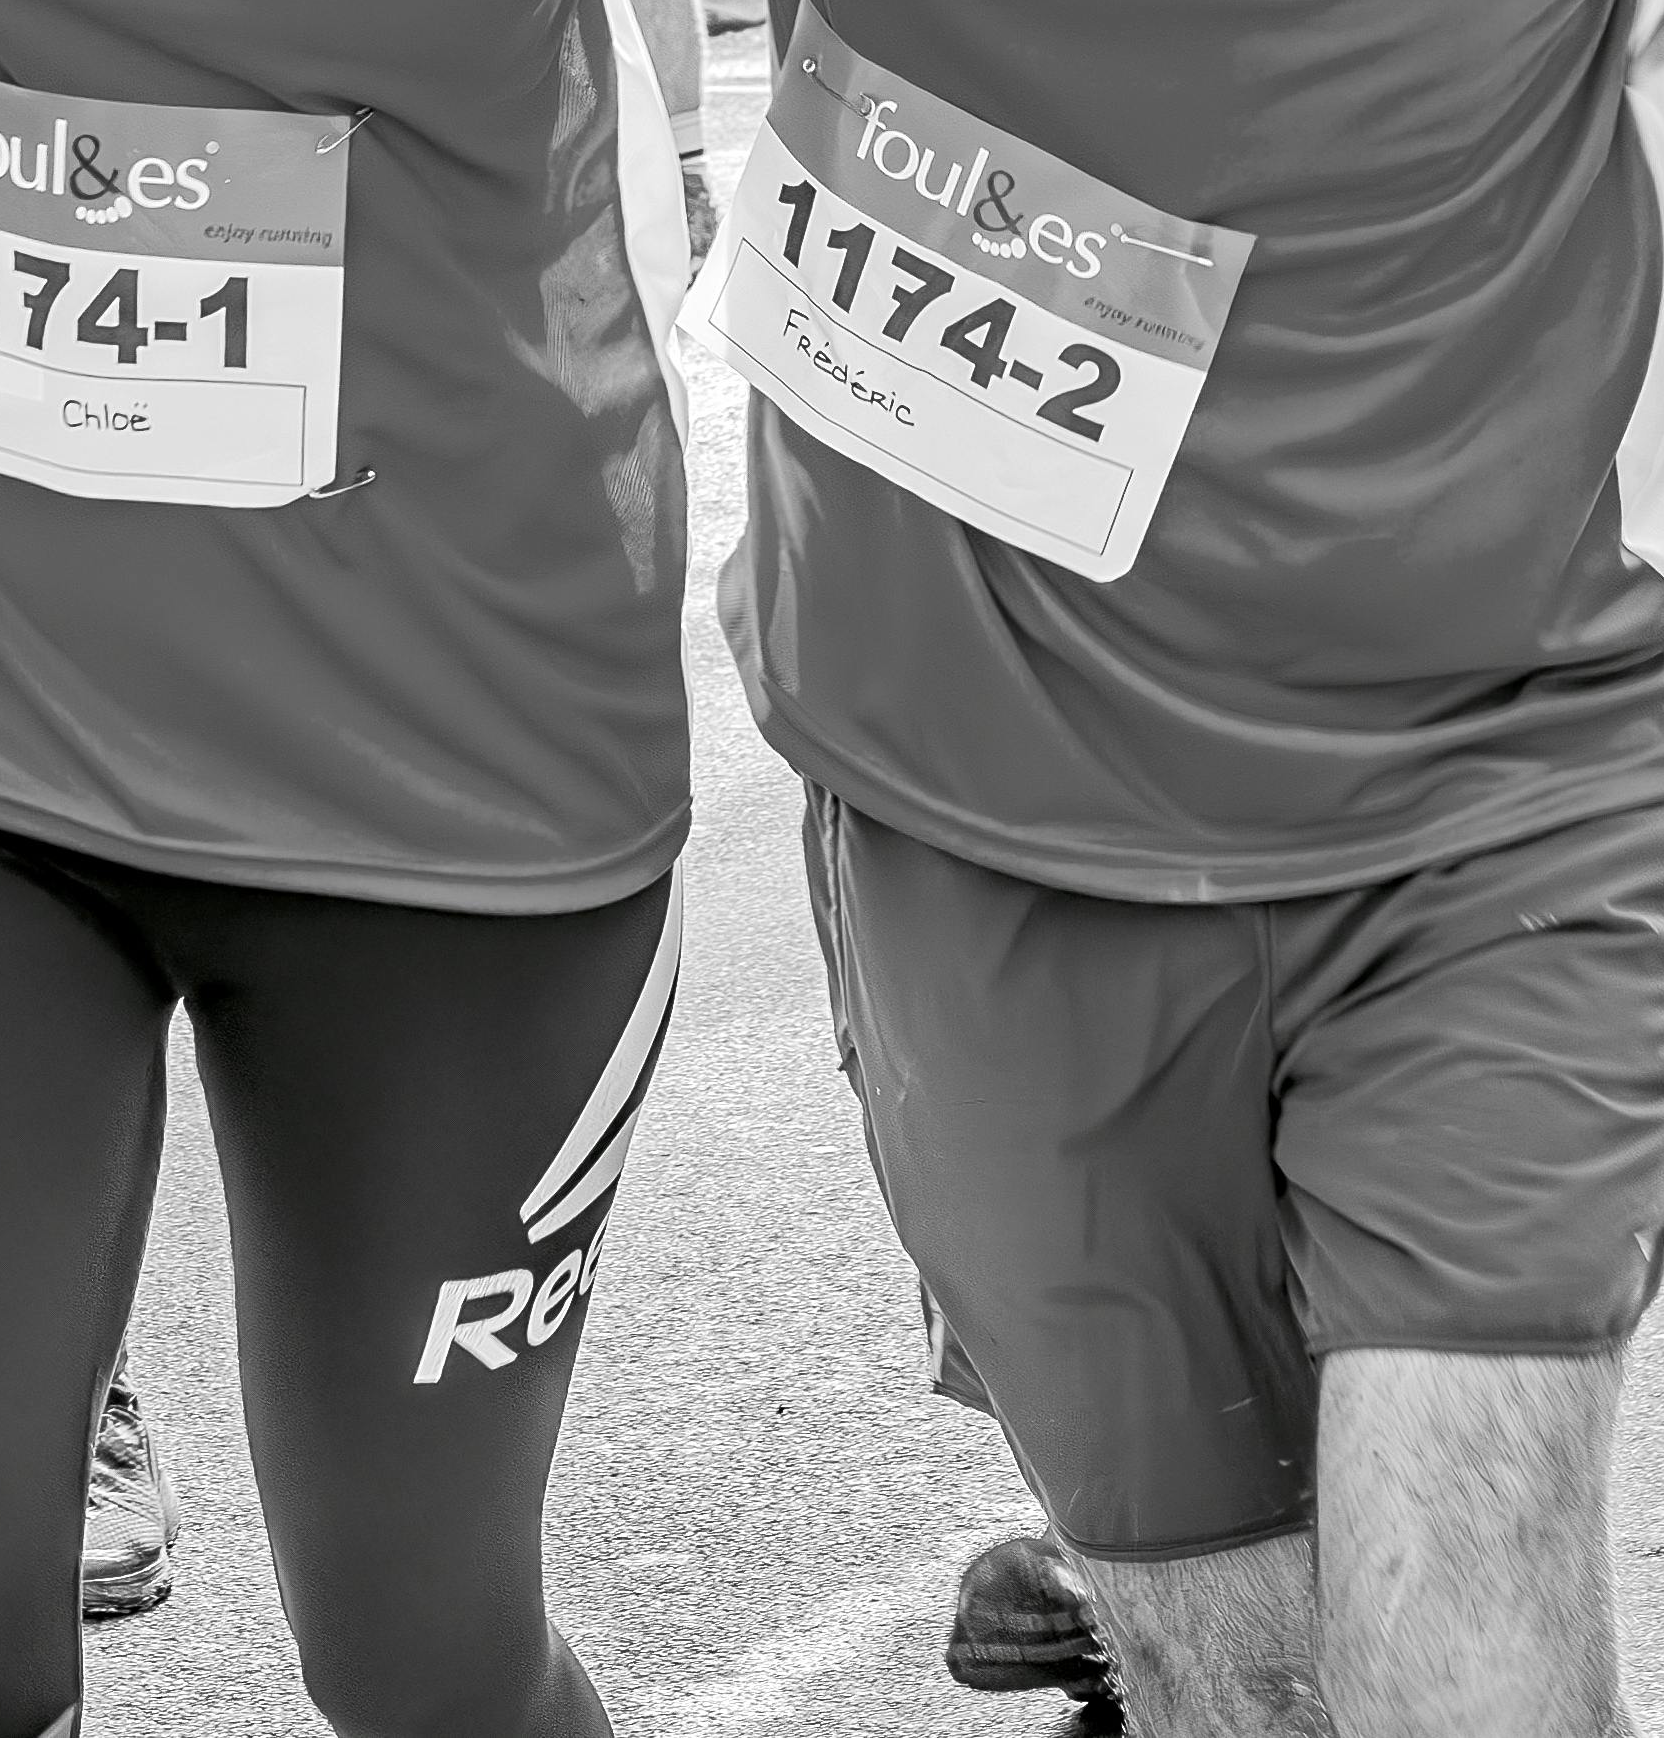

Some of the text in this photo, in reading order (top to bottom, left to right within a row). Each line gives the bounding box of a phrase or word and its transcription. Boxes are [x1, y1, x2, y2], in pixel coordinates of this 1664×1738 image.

[203, 223, 256, 244] enjoy
[855, 98, 1108, 279] foul&es
[777, 178, 1122, 443] 1174-2
[62, 399, 152, 432] Chloë
